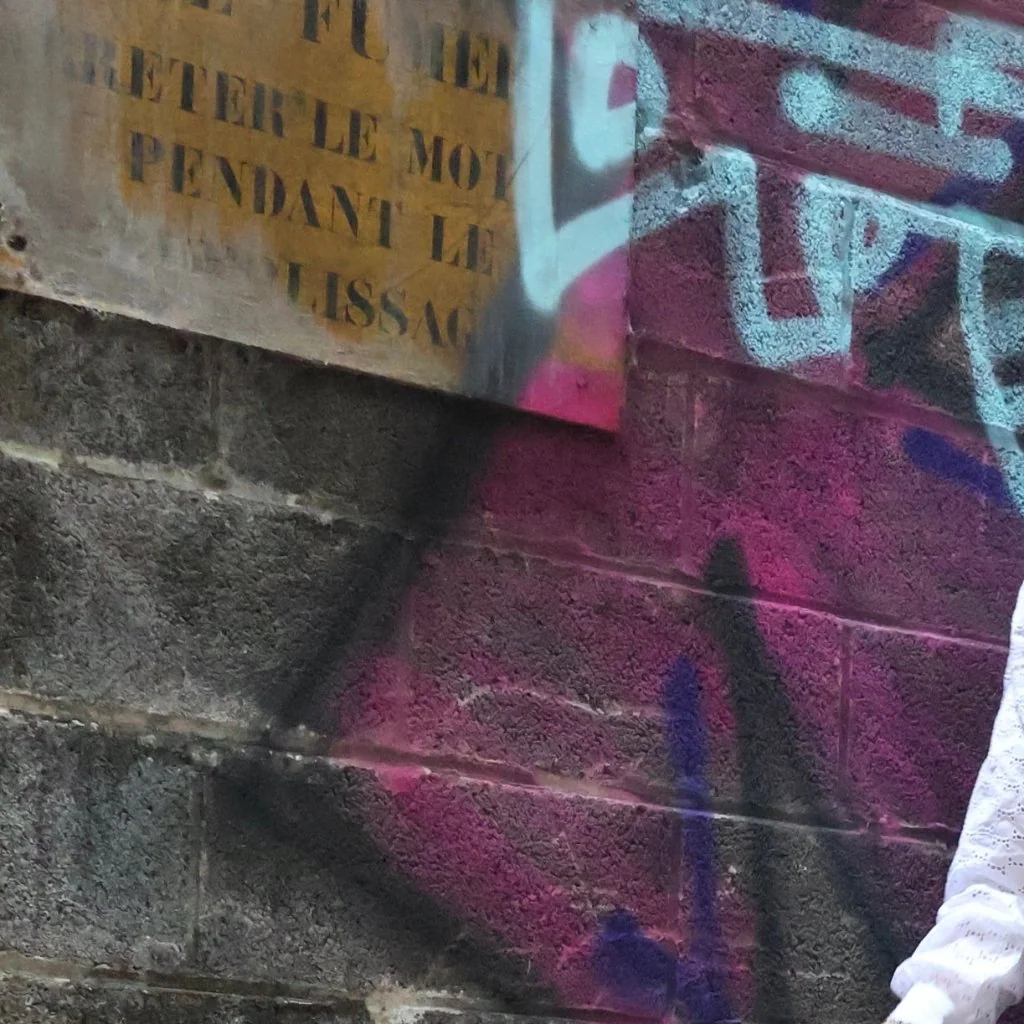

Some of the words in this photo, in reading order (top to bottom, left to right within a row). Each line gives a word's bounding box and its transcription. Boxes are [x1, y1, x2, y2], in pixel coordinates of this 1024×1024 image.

[313, 99, 379, 163] LE
[129, 130, 402, 249] PENDANT
[430, 214, 495, 276] LE
